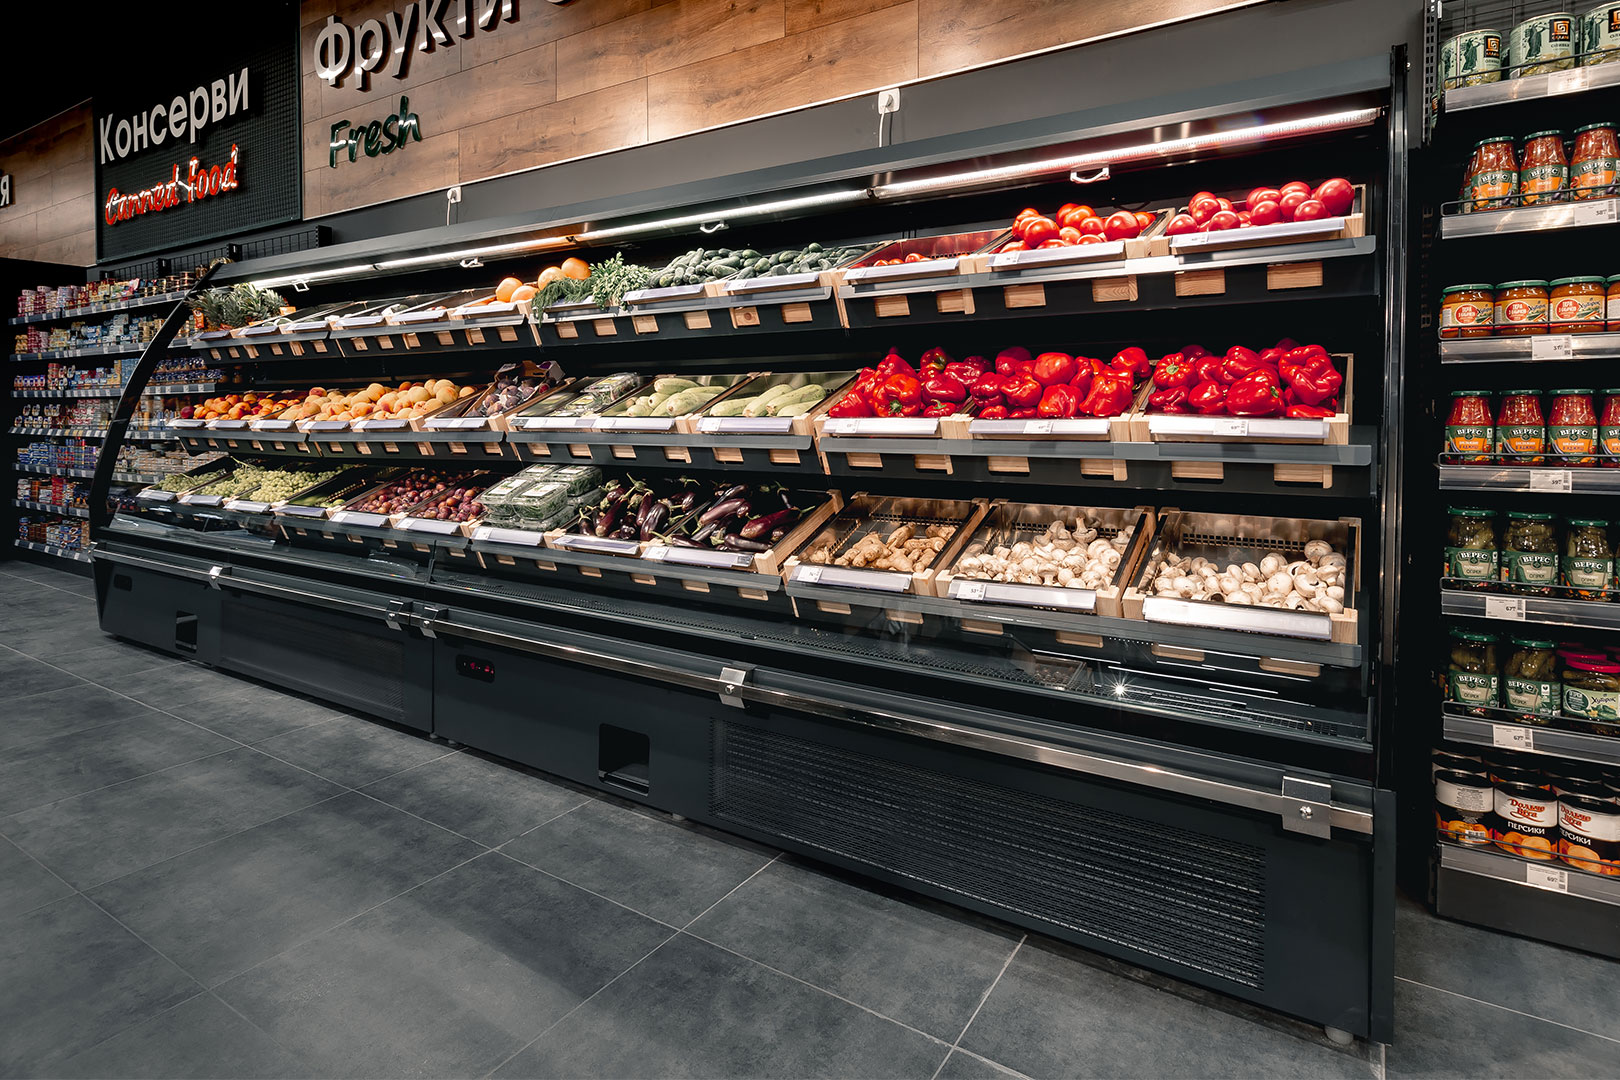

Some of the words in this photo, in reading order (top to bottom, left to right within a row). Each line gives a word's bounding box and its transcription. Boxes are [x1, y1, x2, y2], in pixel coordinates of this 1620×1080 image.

[100, 67, 249, 165] Консерви
[329, 95, 422, 168] Fresh
[105, 163, 181, 226] Canned
[187, 143, 239, 204] food
[1457, 428, 1483, 436] ВЕРЕС
[1512, 428, 1540, 437] ВЕРЕС
[1559, 428, 1589, 437] ВЕРЕС
[1460, 551, 1488, 560] ВЕРЕС
[1522, 555, 1551, 563] ВЕРЕС
[1574, 561, 1603, 570] ВЕРЕС
[1458, 675, 1486, 685] ВЕРЕС
[1507, 680, 1534, 692] ВЕРЕС
[1507, 821, 1545, 835] ПЕРСИКИ
